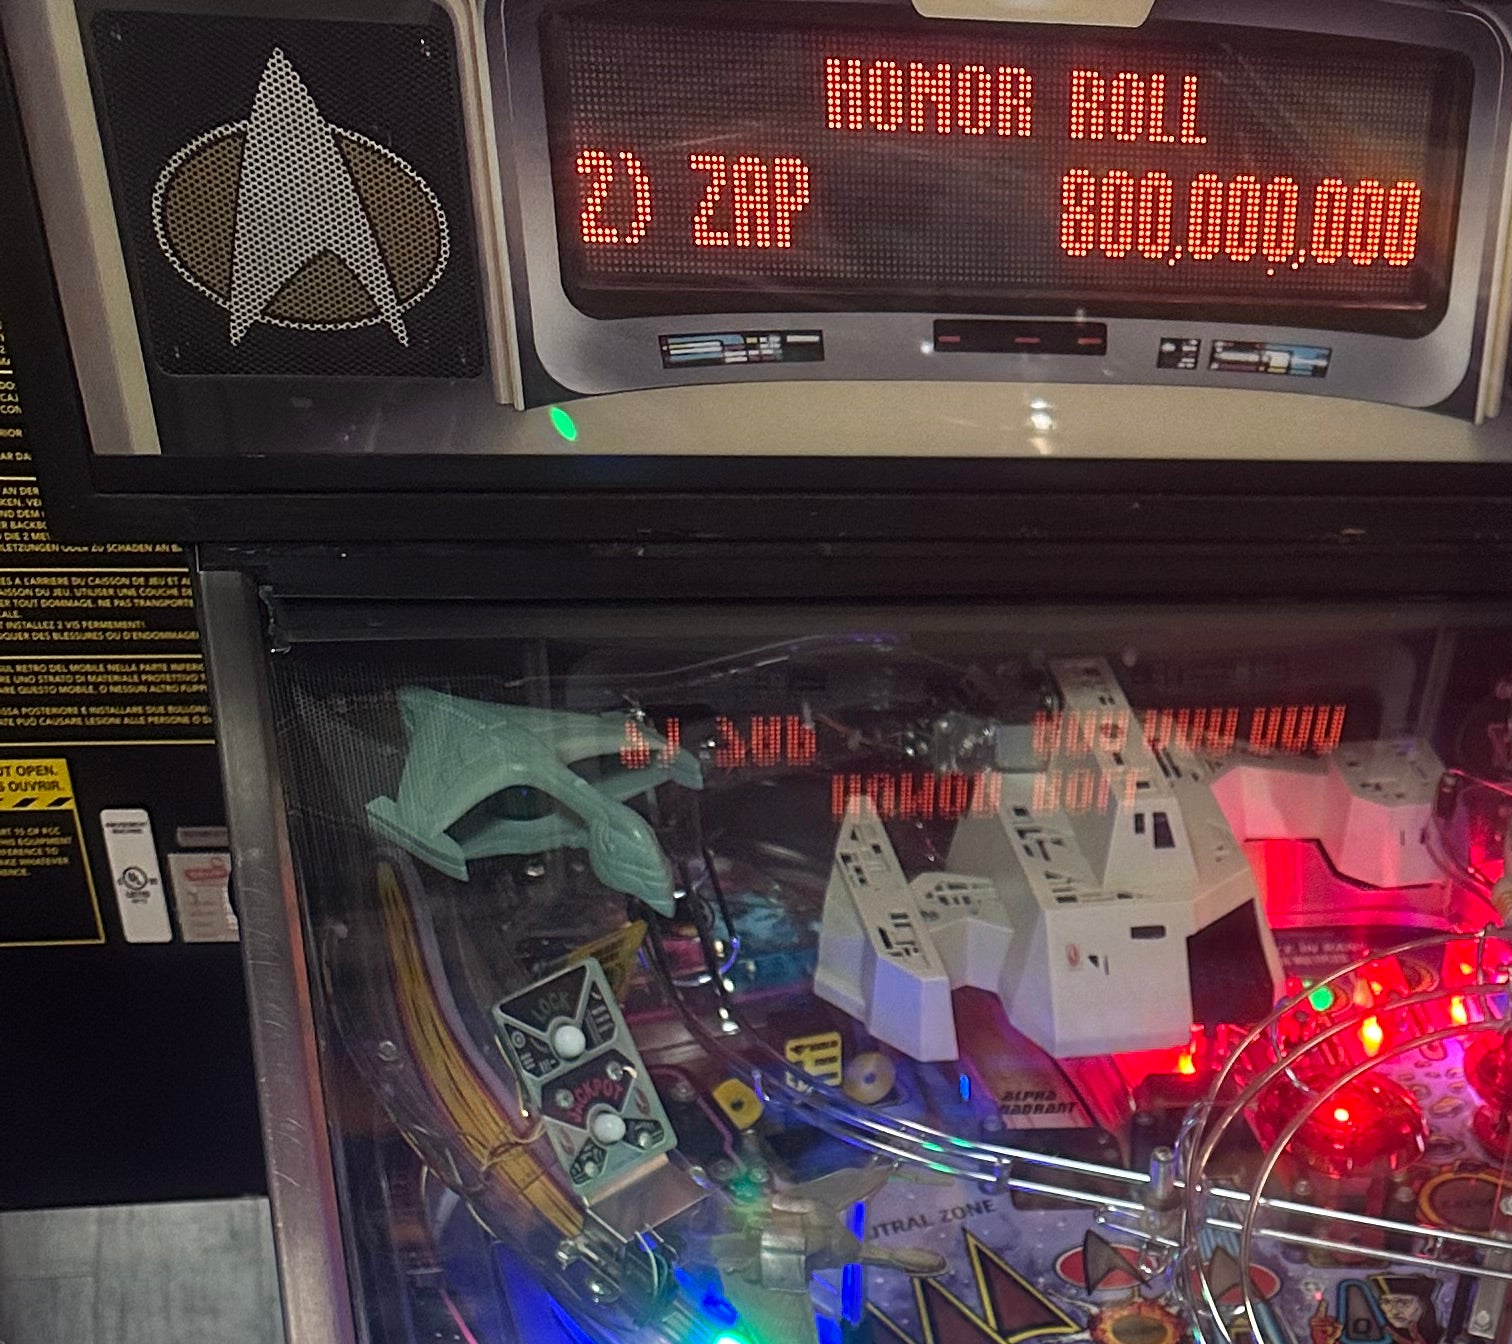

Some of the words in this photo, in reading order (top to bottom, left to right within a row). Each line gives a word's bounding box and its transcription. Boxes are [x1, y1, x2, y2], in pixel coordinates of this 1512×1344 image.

[826, 58, 1034, 137] HONOR
[1069, 69, 1208, 145] ROLL
[576, 150, 653, 244] 2)
[688, 154, 811, 249] ZAP
[569, 1078, 624, 1123] JACKPOT
[1002, 1091, 1057, 1102] ALPHA
[940, 1199, 999, 1224] ZONE
